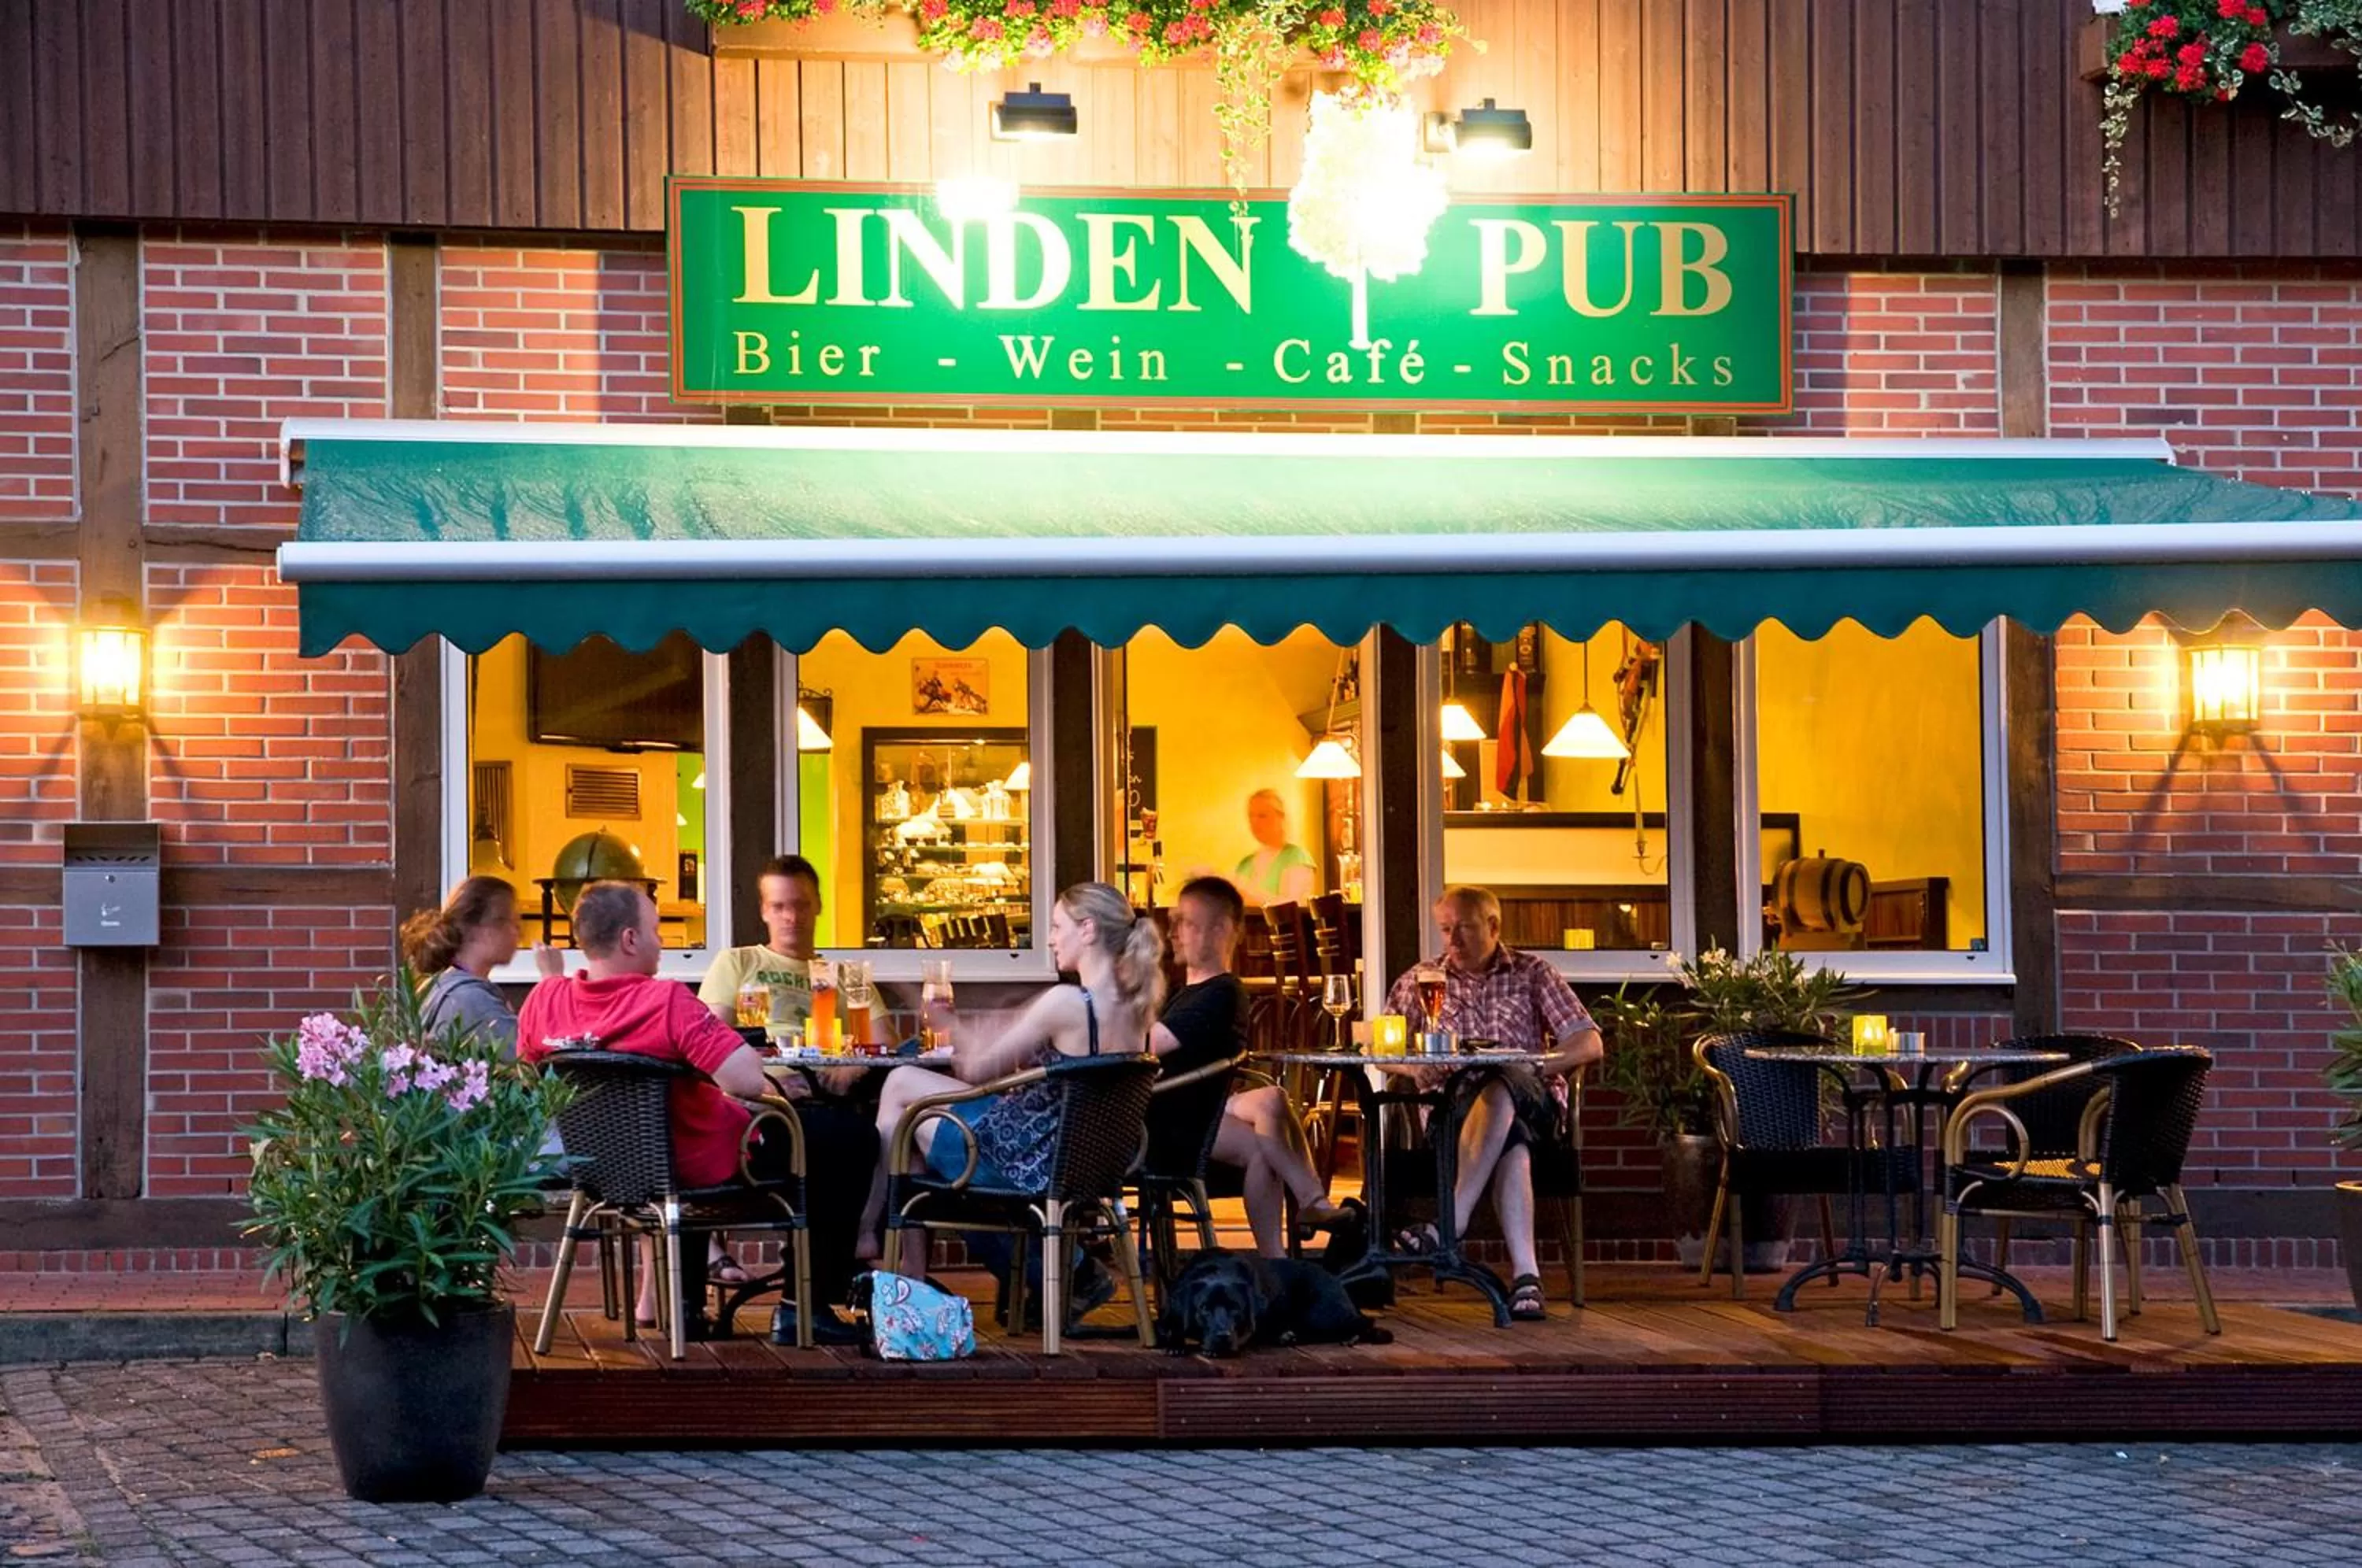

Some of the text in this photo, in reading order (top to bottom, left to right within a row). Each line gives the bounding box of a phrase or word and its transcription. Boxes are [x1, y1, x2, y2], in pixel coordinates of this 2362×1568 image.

[731, 205, 1732, 317] LINDEN PUB
[733, 331, 881, 375] Bier
[998, 335, 1168, 379] Wein
[1273, 338, 1426, 384] Café
[1502, 342, 1733, 386] Snacks
